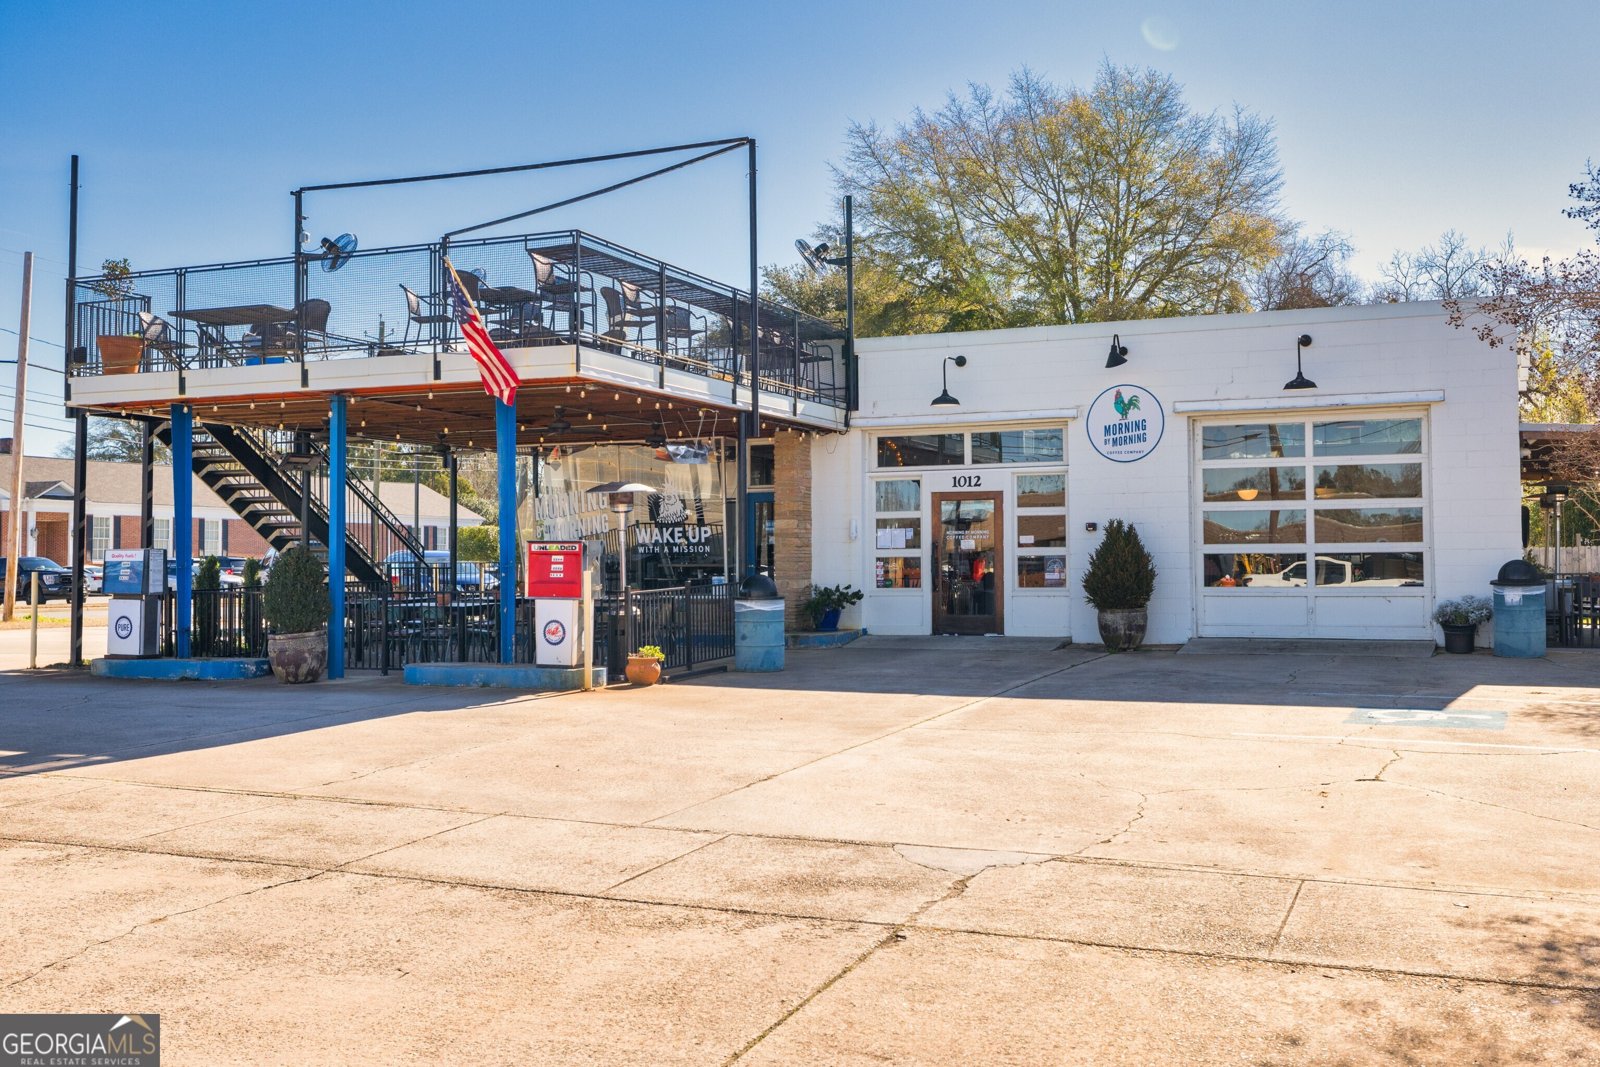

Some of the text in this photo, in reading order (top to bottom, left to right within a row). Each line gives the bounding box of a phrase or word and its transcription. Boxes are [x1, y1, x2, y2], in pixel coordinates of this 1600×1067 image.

[1104, 418, 1146, 437] MORNING
[1104, 432, 1146, 447] BY MORNING
[951, 475, 982, 488] 1012
[534, 490, 608, 520] MORNING
[635, 526, 711, 544] WAKE UP
[637, 546, 660, 554] WITH
[673, 545, 710, 553] MISSION
[118, 624, 130, 632] PURE
